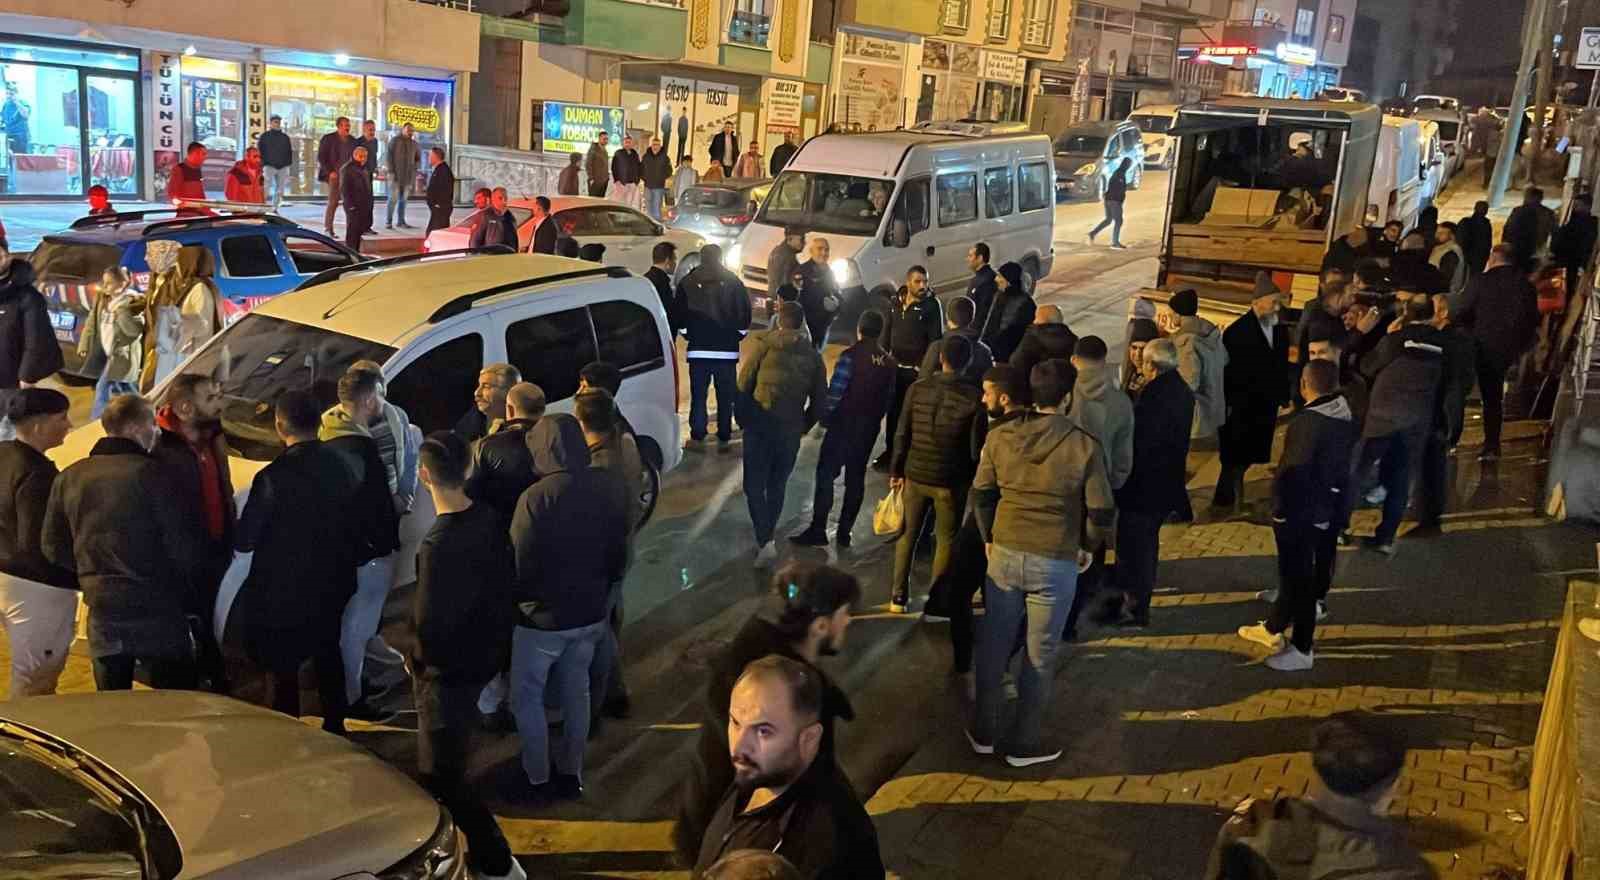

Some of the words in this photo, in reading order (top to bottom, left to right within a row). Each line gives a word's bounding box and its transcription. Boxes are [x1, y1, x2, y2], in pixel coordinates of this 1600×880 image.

[160, 55, 173, 148] TÜTÜNCÜ
[249, 63, 261, 146] TÜTÜNC
[706, 86, 728, 106] TEKSTİL
[565, 106, 603, 124] DUMAN
[561, 123, 604, 144] TOBACC
